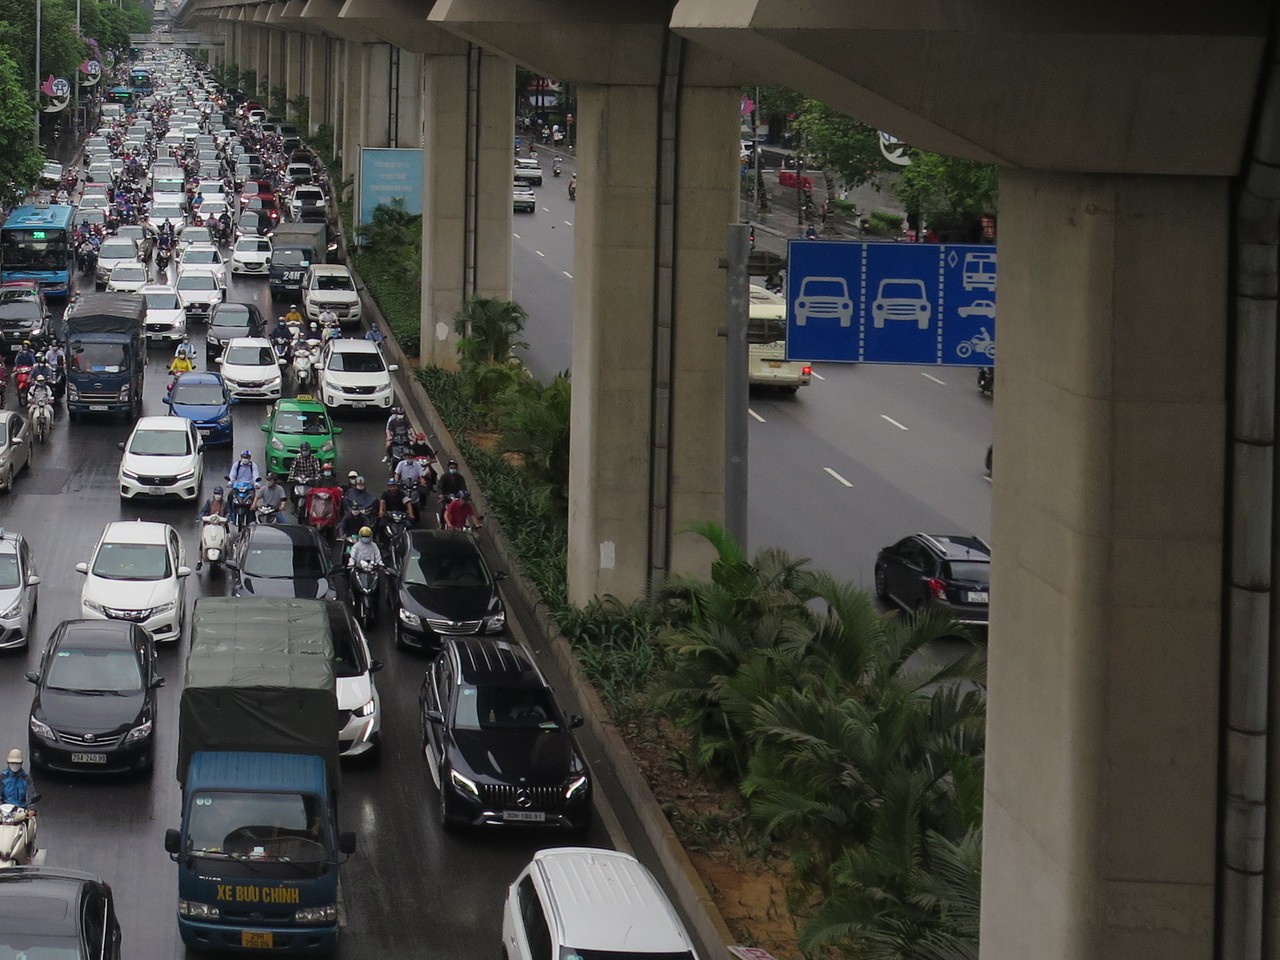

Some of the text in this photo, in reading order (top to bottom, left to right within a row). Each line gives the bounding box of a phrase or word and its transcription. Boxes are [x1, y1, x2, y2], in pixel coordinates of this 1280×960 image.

[283, 271, 300, 280] 24H
[216, 884, 299, 903] XE BƯU CHÍNH
